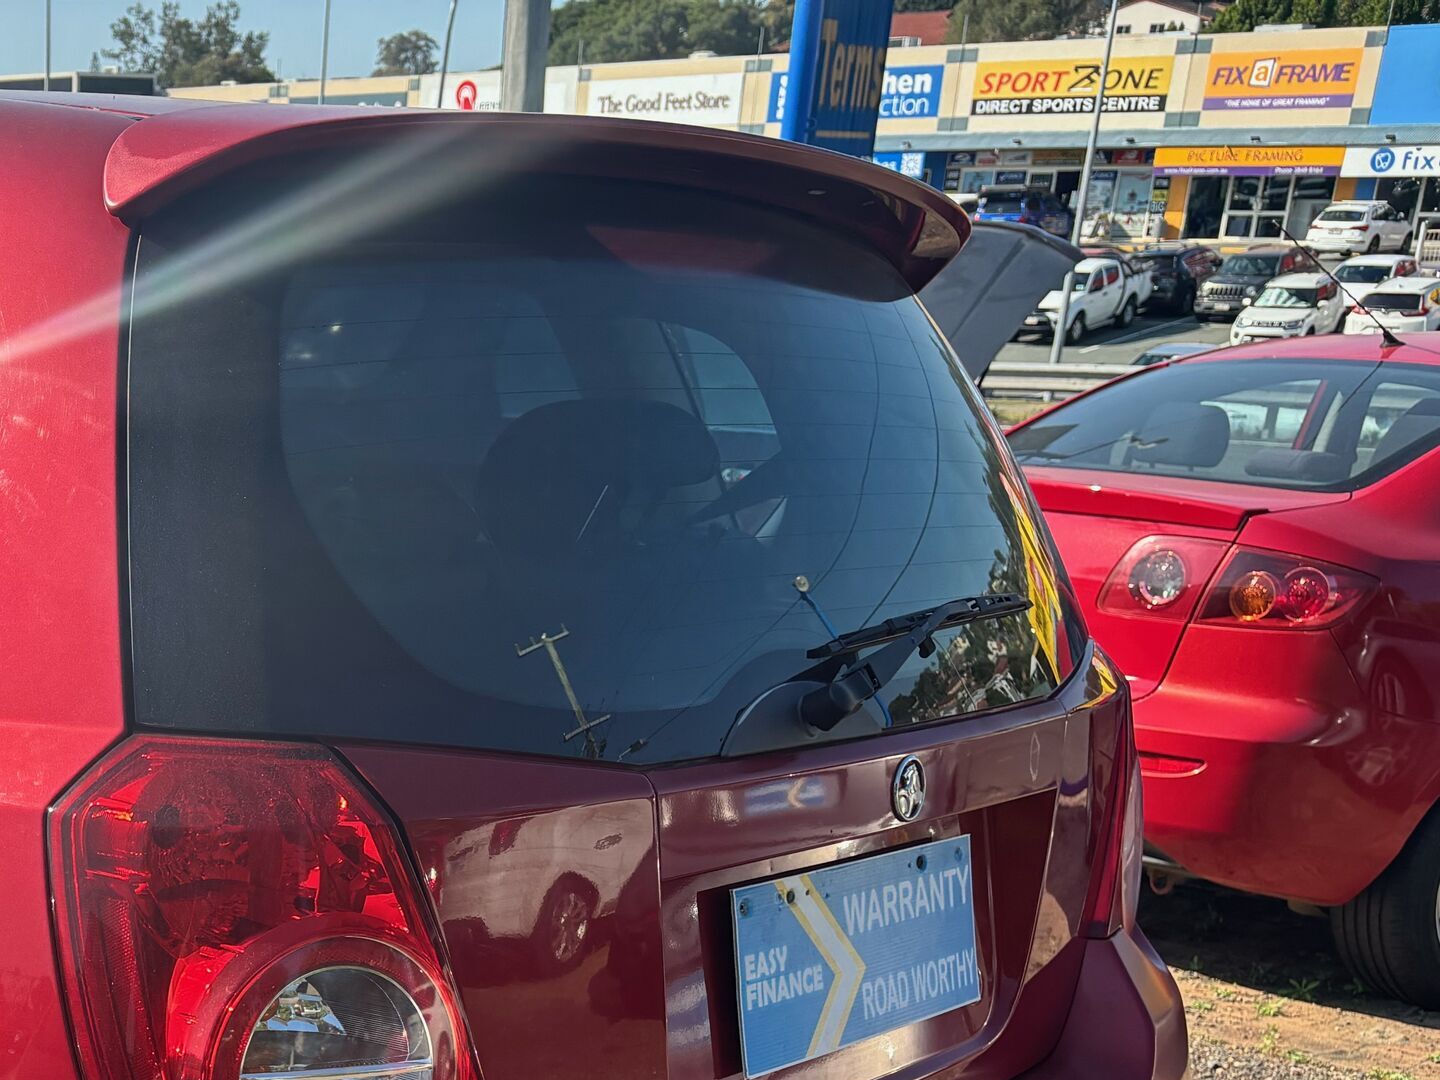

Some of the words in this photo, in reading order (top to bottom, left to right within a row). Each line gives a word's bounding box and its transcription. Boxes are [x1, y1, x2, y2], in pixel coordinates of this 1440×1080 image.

[1213, 66, 1249, 86] FIX
[1275, 62, 1355, 84] FRAME
[599, 95, 622, 114] The
[625, 92, 662, 112] Good
[664, 92, 691, 111] Feet
[694, 91, 731, 110] Store
[976, 99, 1029, 113] DIRECT
[1032, 97, 1093, 112] SPORTS
[1187, 150, 1239, 162] PICTURE
[1244, 148, 1304, 162] FRAMING
[842, 864, 969, 936] WARRANTY
[744, 945, 788, 981] EASY
[746, 964, 824, 1011] FINANCE
[862, 971, 909, 1020] ROAD
[912, 947, 976, 1003] WORTHY
